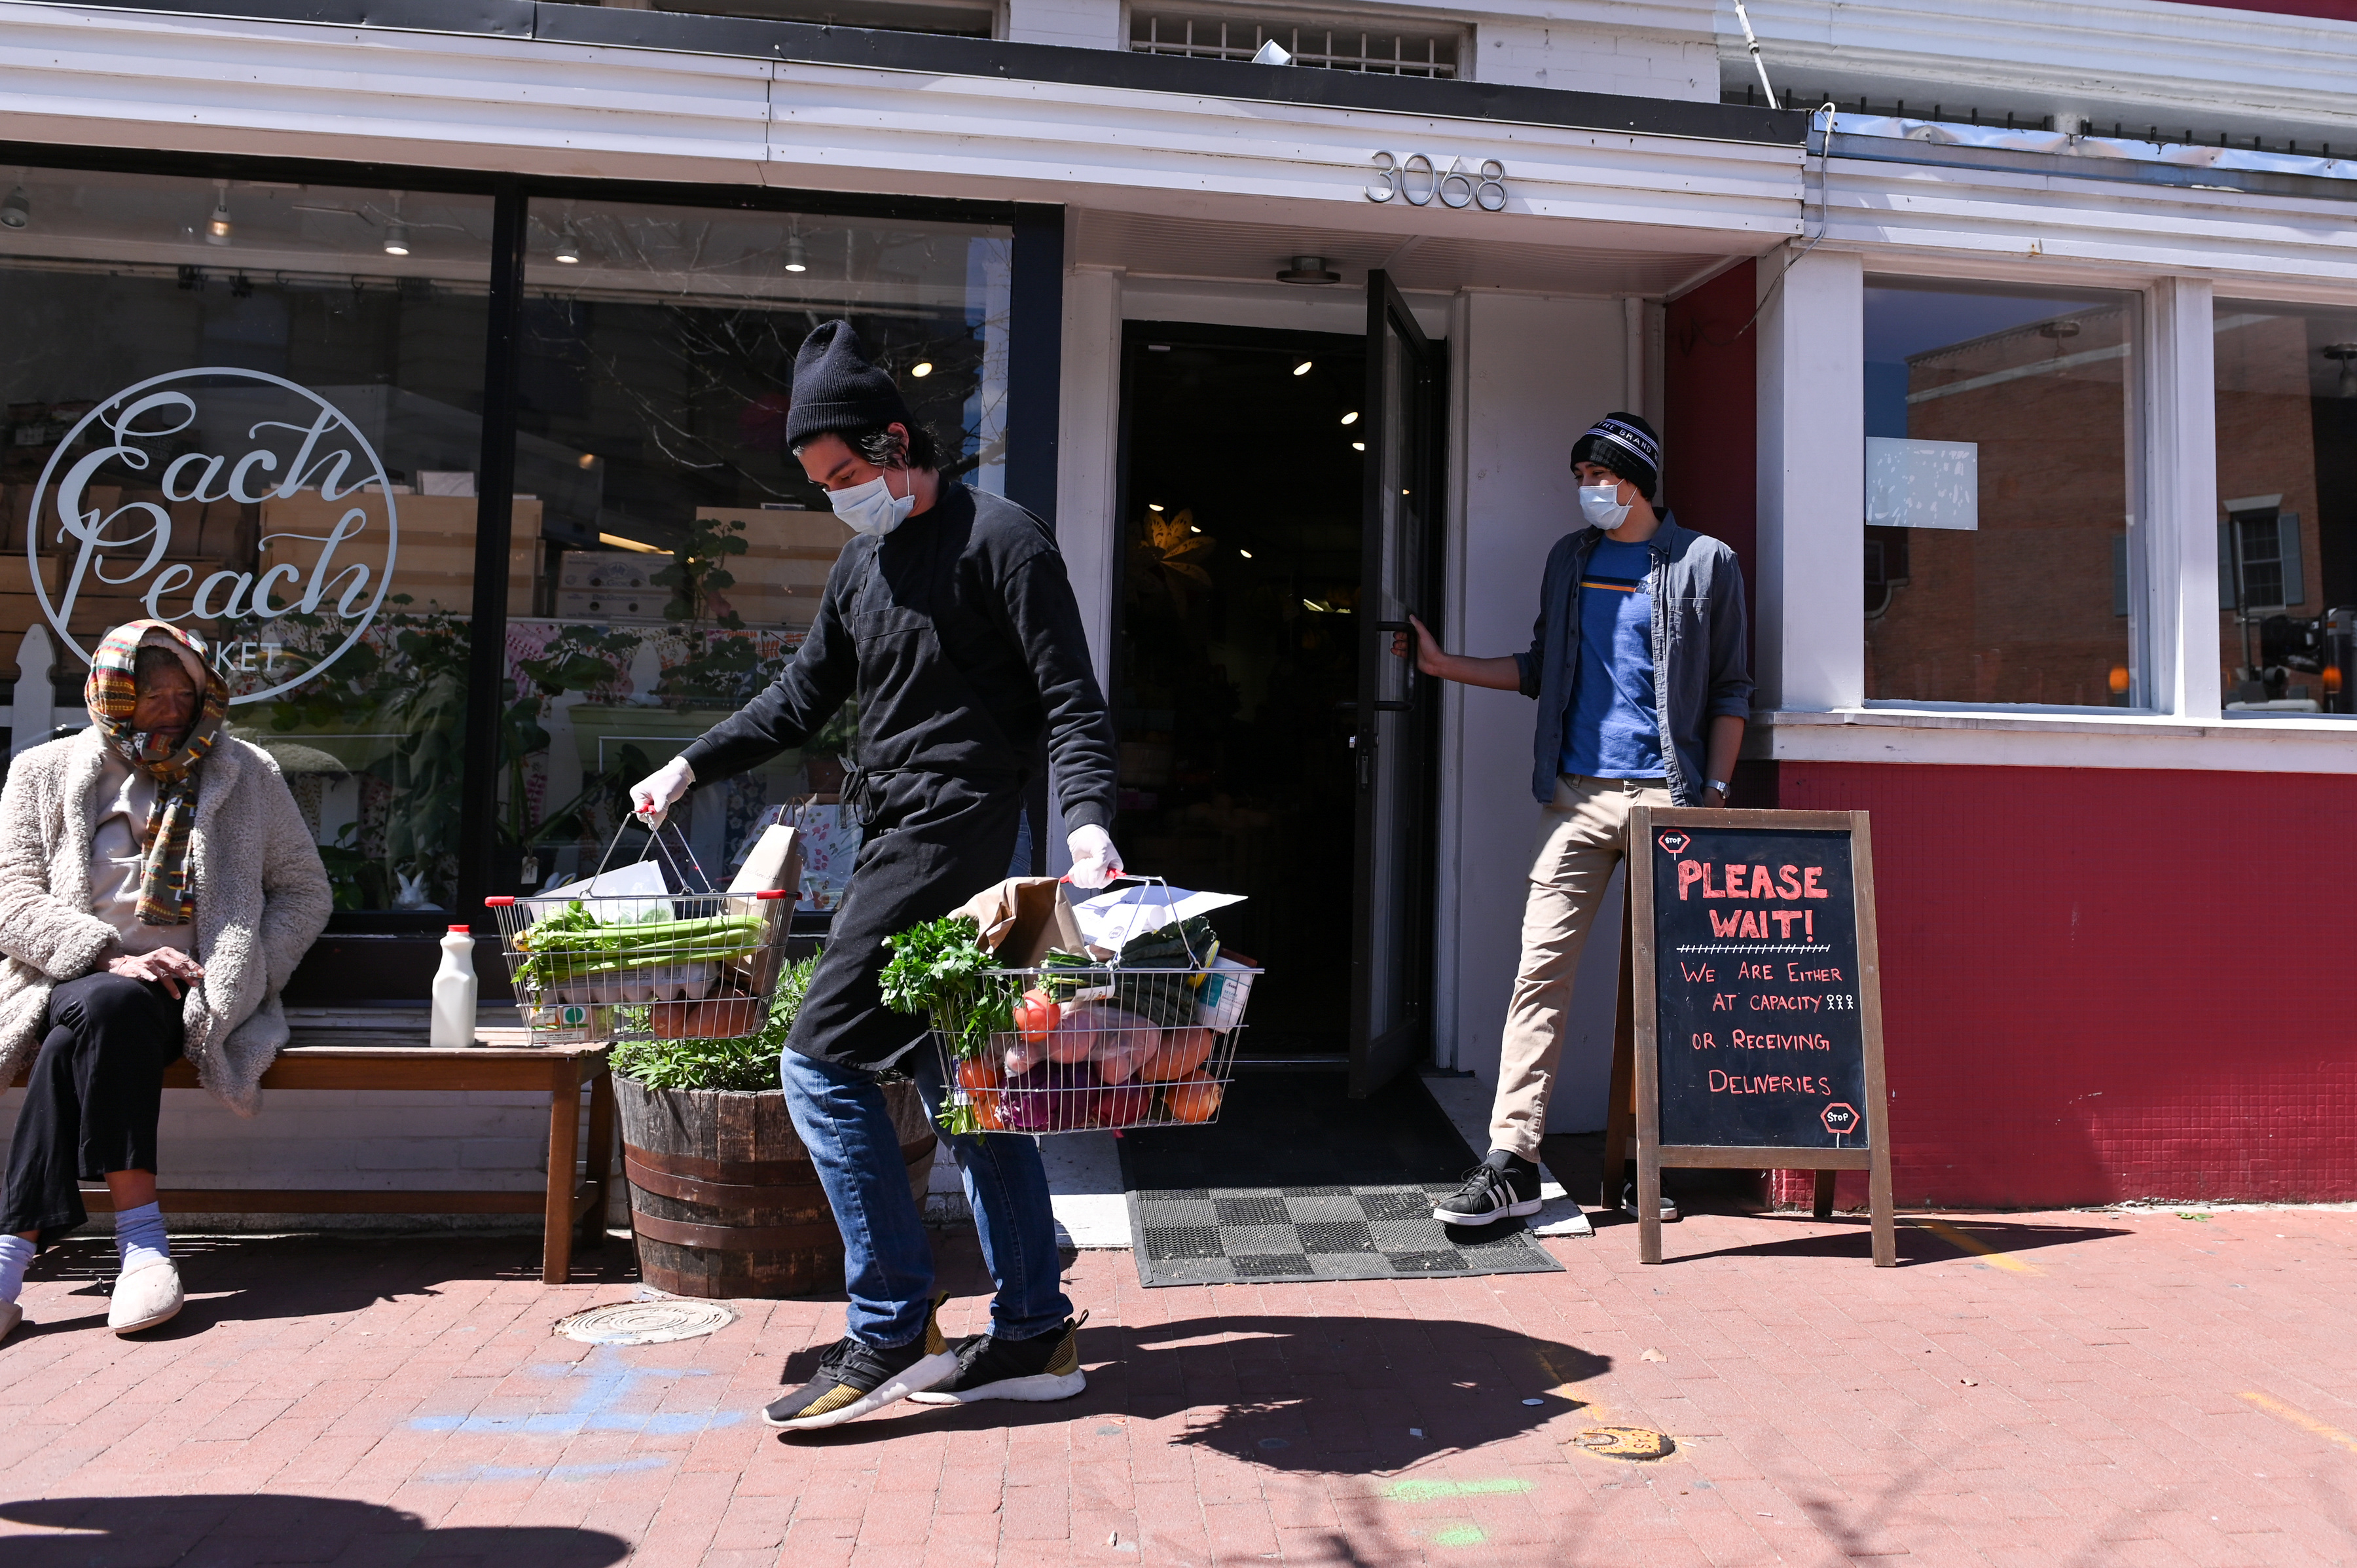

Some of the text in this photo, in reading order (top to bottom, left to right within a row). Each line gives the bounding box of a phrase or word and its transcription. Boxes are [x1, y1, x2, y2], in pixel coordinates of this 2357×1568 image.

[1363, 149, 1508, 211] 3068
[1598, 421, 1652, 454] THE BRAND
[58, 391, 382, 541] Each
[57, 501, 372, 631] Peach
[199, 640, 282, 672] KET
[1664, 837, 1682, 845] STOP
[1677, 859, 1828, 901] PLEASE
[1709, 909, 1814, 943] WAIT!
[1681, 960, 1842, 983] WE ARE EITHER
[1712, 994, 1823, 1013] AT CAPACITY
[1692, 1029, 1831, 1051] OR RECEIVING
[1708, 1069, 1832, 1096] DELIVERIES
[1827, 1112, 1849, 1122] STOP
